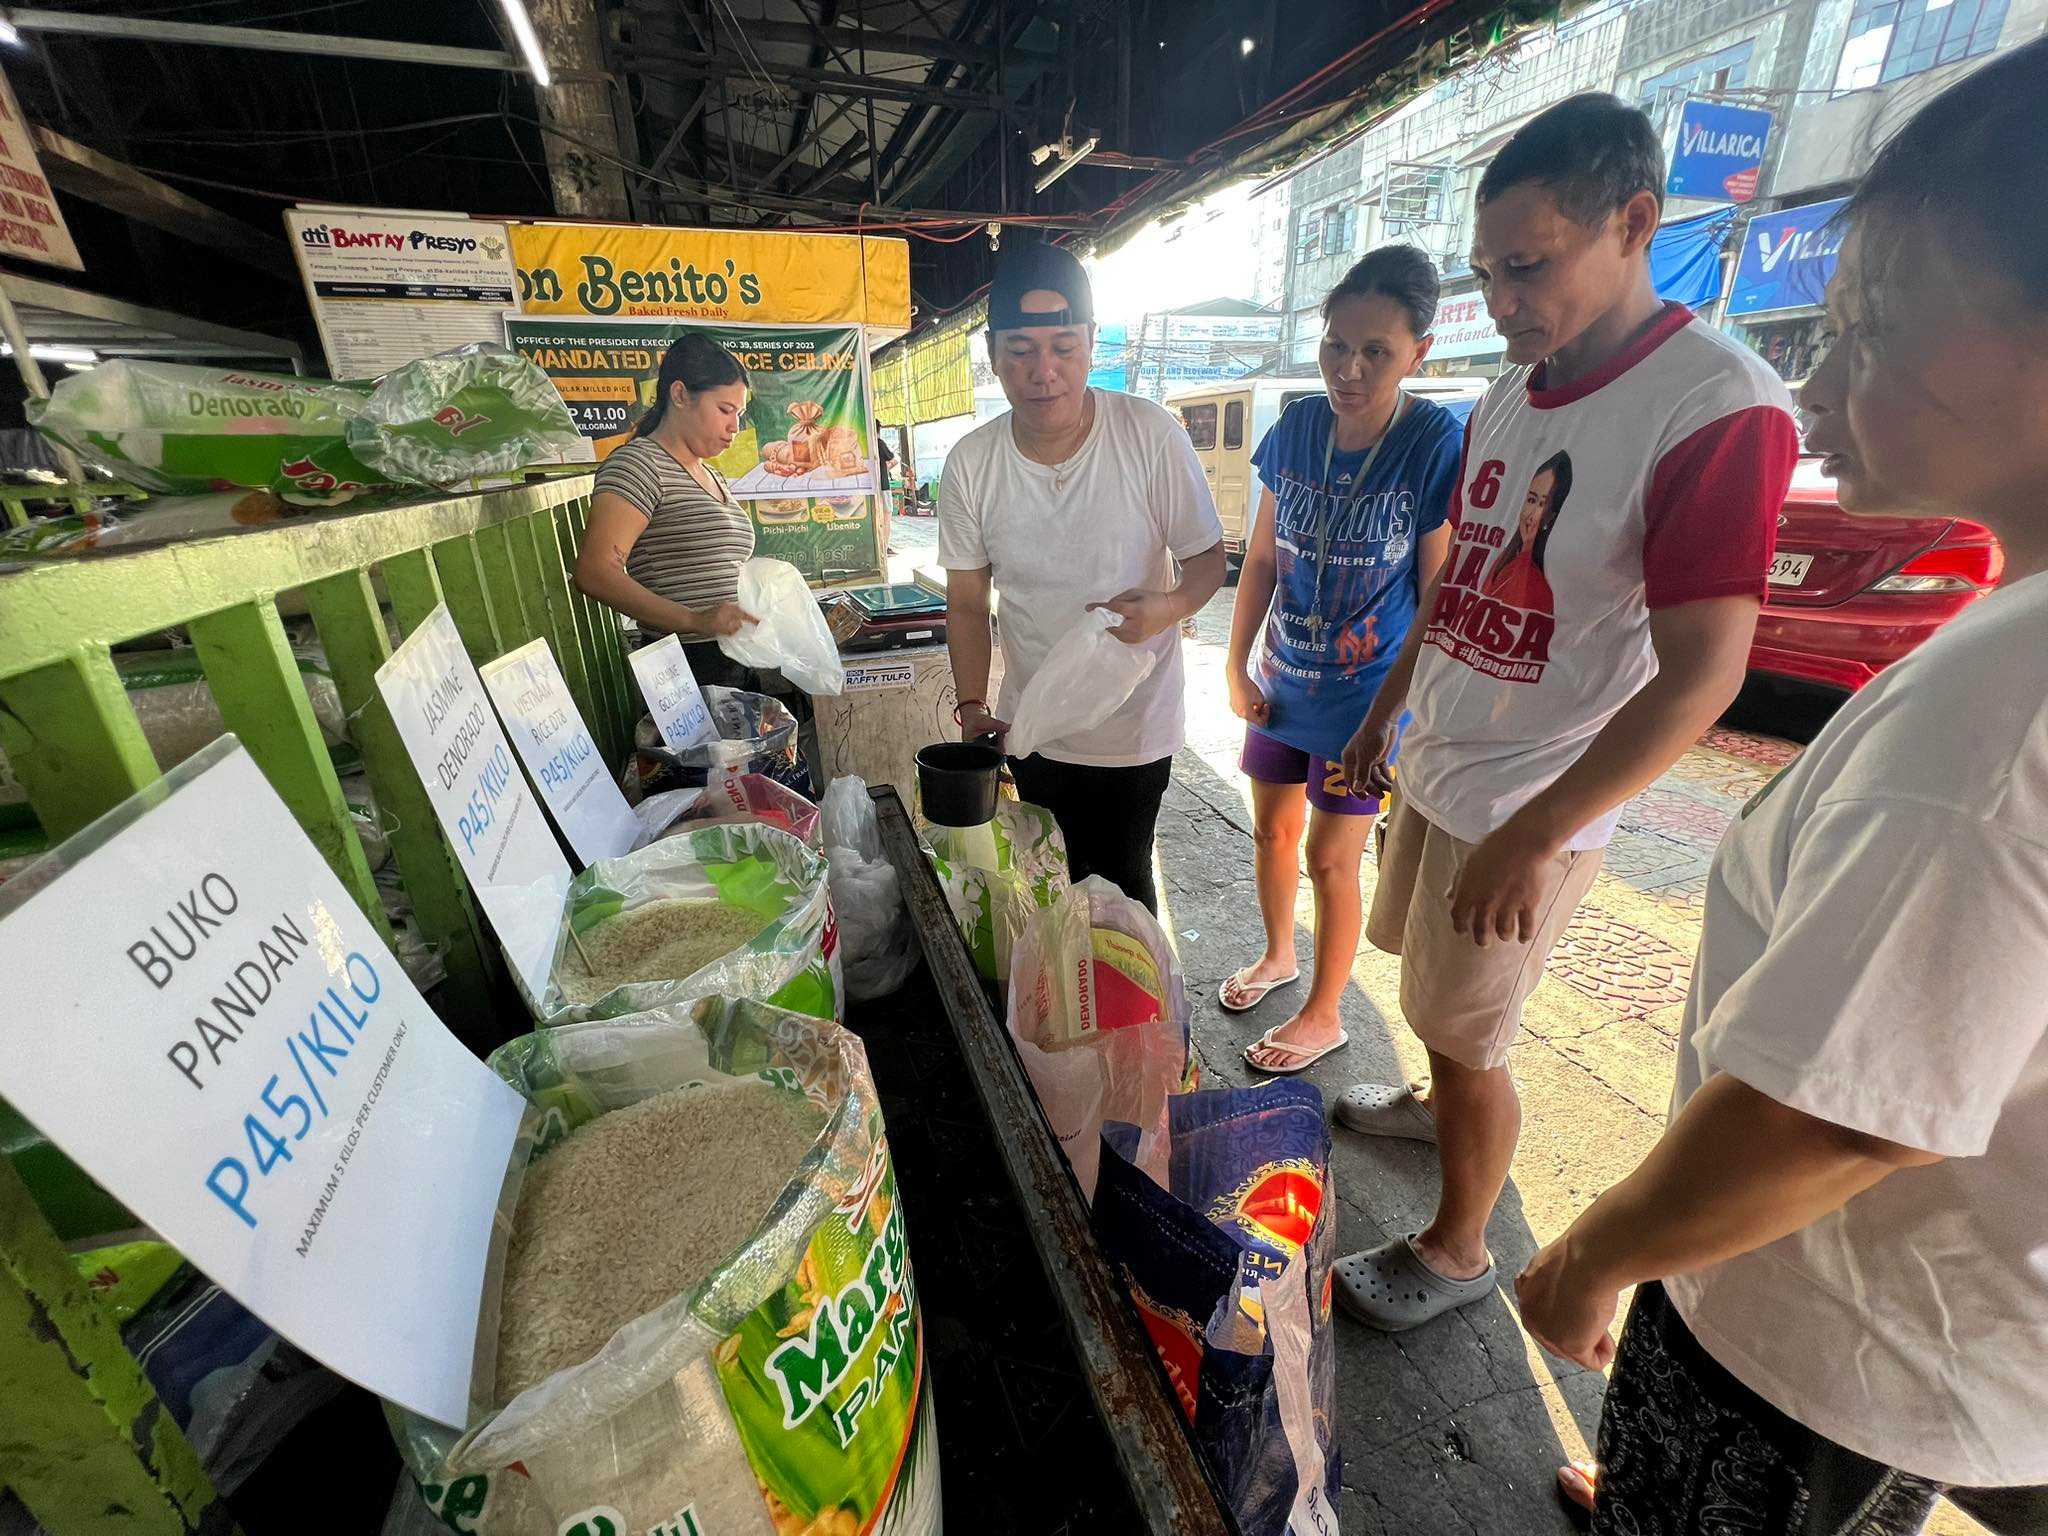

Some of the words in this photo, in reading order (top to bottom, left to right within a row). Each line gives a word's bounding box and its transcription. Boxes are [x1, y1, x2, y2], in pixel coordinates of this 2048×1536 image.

[1683, 122, 1762, 158] VILLARICA
[302, 223, 330, 247] dti
[330, 227, 404, 251] BANTAY
[408, 230, 477, 254] PRESYO
[577, 254, 762, 316] Benito's
[628, 304, 664, 317] Baked
[666, 305, 699, 318] Fresh
[701, 307, 729, 319] Daily
[515, 335, 551, 345] OFFICE
[553, 336, 566, 346] OF
[569, 337, 587, 346] THE
[589, 337, 639, 347] PRESIDENT
[722, 340, 738, 350] NO.
[753, 341, 782, 350] SERIES
[783, 342, 794, 350] OF
[795, 340, 815, 350] 2023
[519, 348, 651, 370] MANDATED
[188, 391, 305, 420] Denorado
[613, 385, 632, 393] RICE
[583, 407, 627, 421] 41.00
[1468, 459, 1505, 510] 6
[1300, 549, 1376, 567] PICHERS
[846, 675, 878, 685] RAFFY
[881, 672, 912, 682] TULFO
[1270, 655, 1322, 680] OUTFIELDERS
[421, 667, 464, 736] JASMINE
[512, 682, 555, 717] VIETNAM
[530, 721, 552, 748] RICE
[665, 703, 705, 743] P45/KILO
[436, 701, 486, 791] DENORADO
[539, 731, 592, 793] P45/KILO
[457, 742, 511, 856] P45/KILO
[126, 871, 239, 990] BUKO
[167, 911, 311, 1090] PANDAN
[204, 950, 382, 1229] P45/KILO
[296, 1173, 340, 1258] MAXIMUM
[334, 1163, 345, 1176] 5
[341, 1126, 361, 1165] KILOS
[355, 1103, 370, 1128] PER
[366, 1046, 398, 1105] CUSTOMER
[392, 1020, 408, 1048] ONLY
